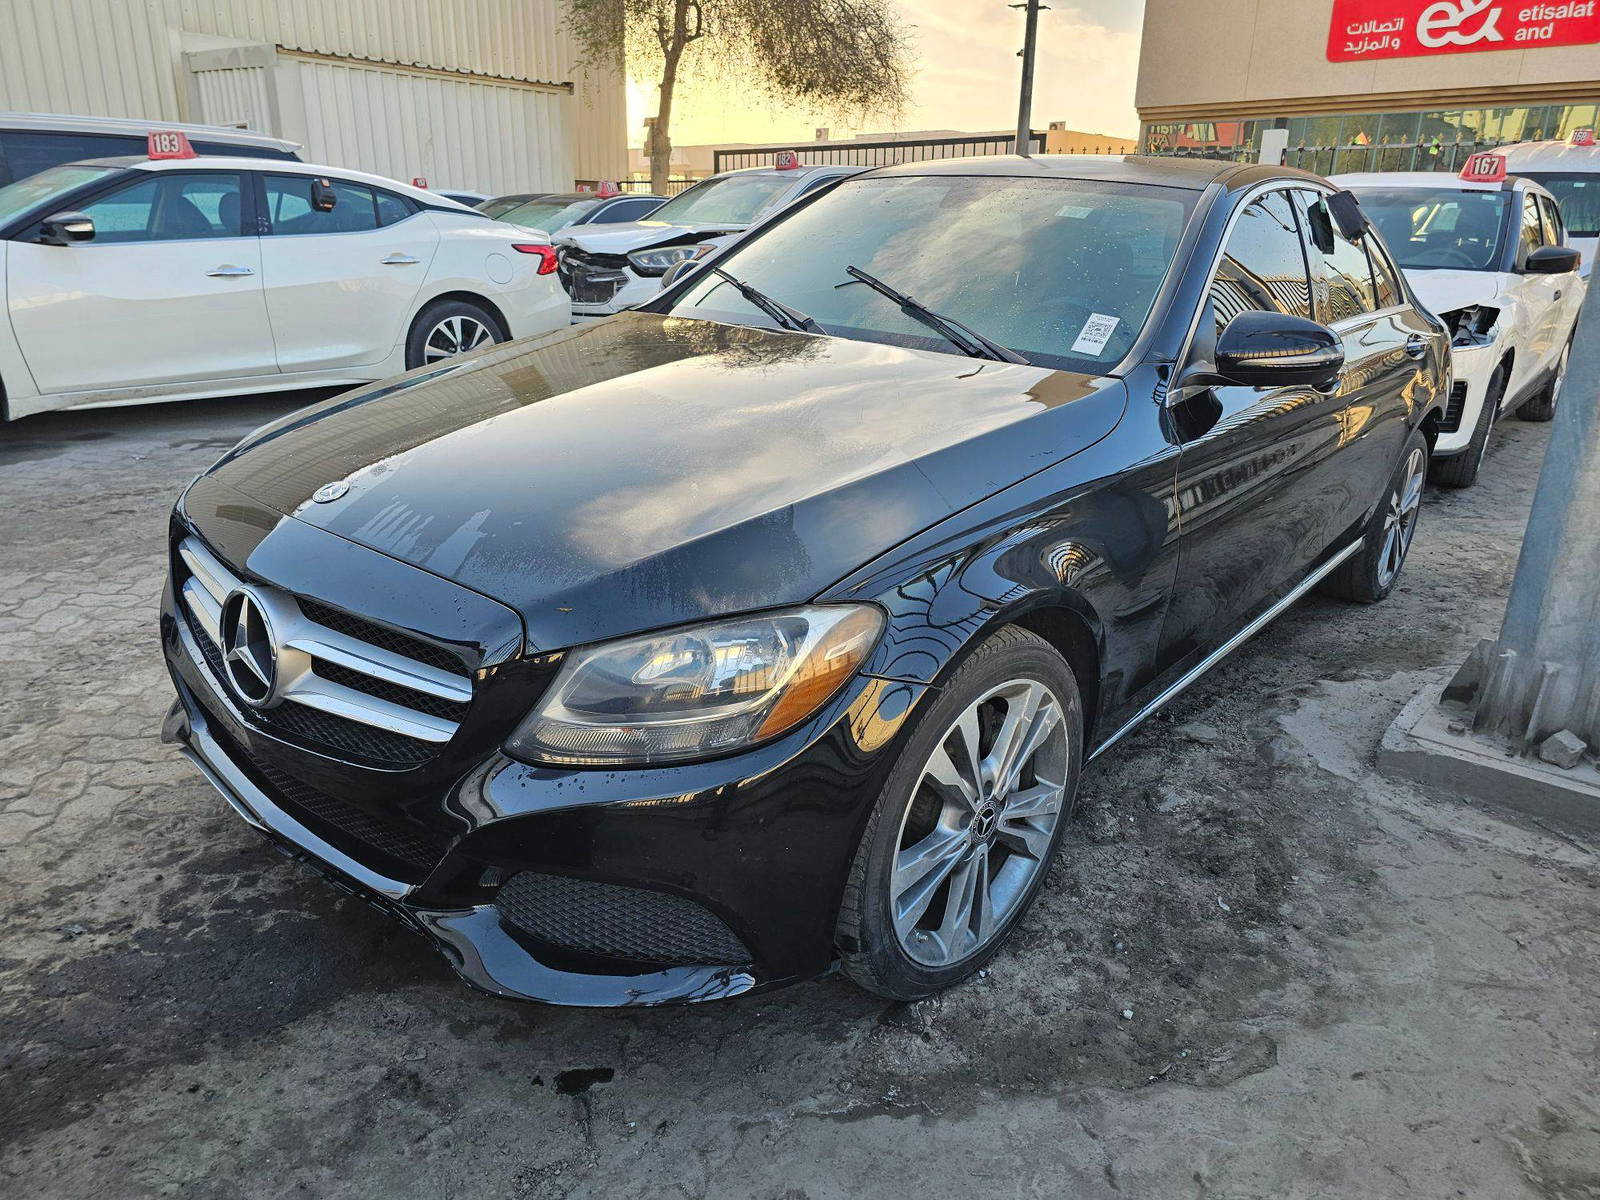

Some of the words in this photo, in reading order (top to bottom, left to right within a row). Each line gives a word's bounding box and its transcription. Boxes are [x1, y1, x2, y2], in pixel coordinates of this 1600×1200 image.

[1519, 1, 1596, 22] etisalat
[1347, 17, 1404, 35] اتصالات
[1514, 23, 1553, 41] and
[153, 134, 179, 153] 183
[778, 154, 791, 165] 182
[1473, 157, 1500, 175] 167
